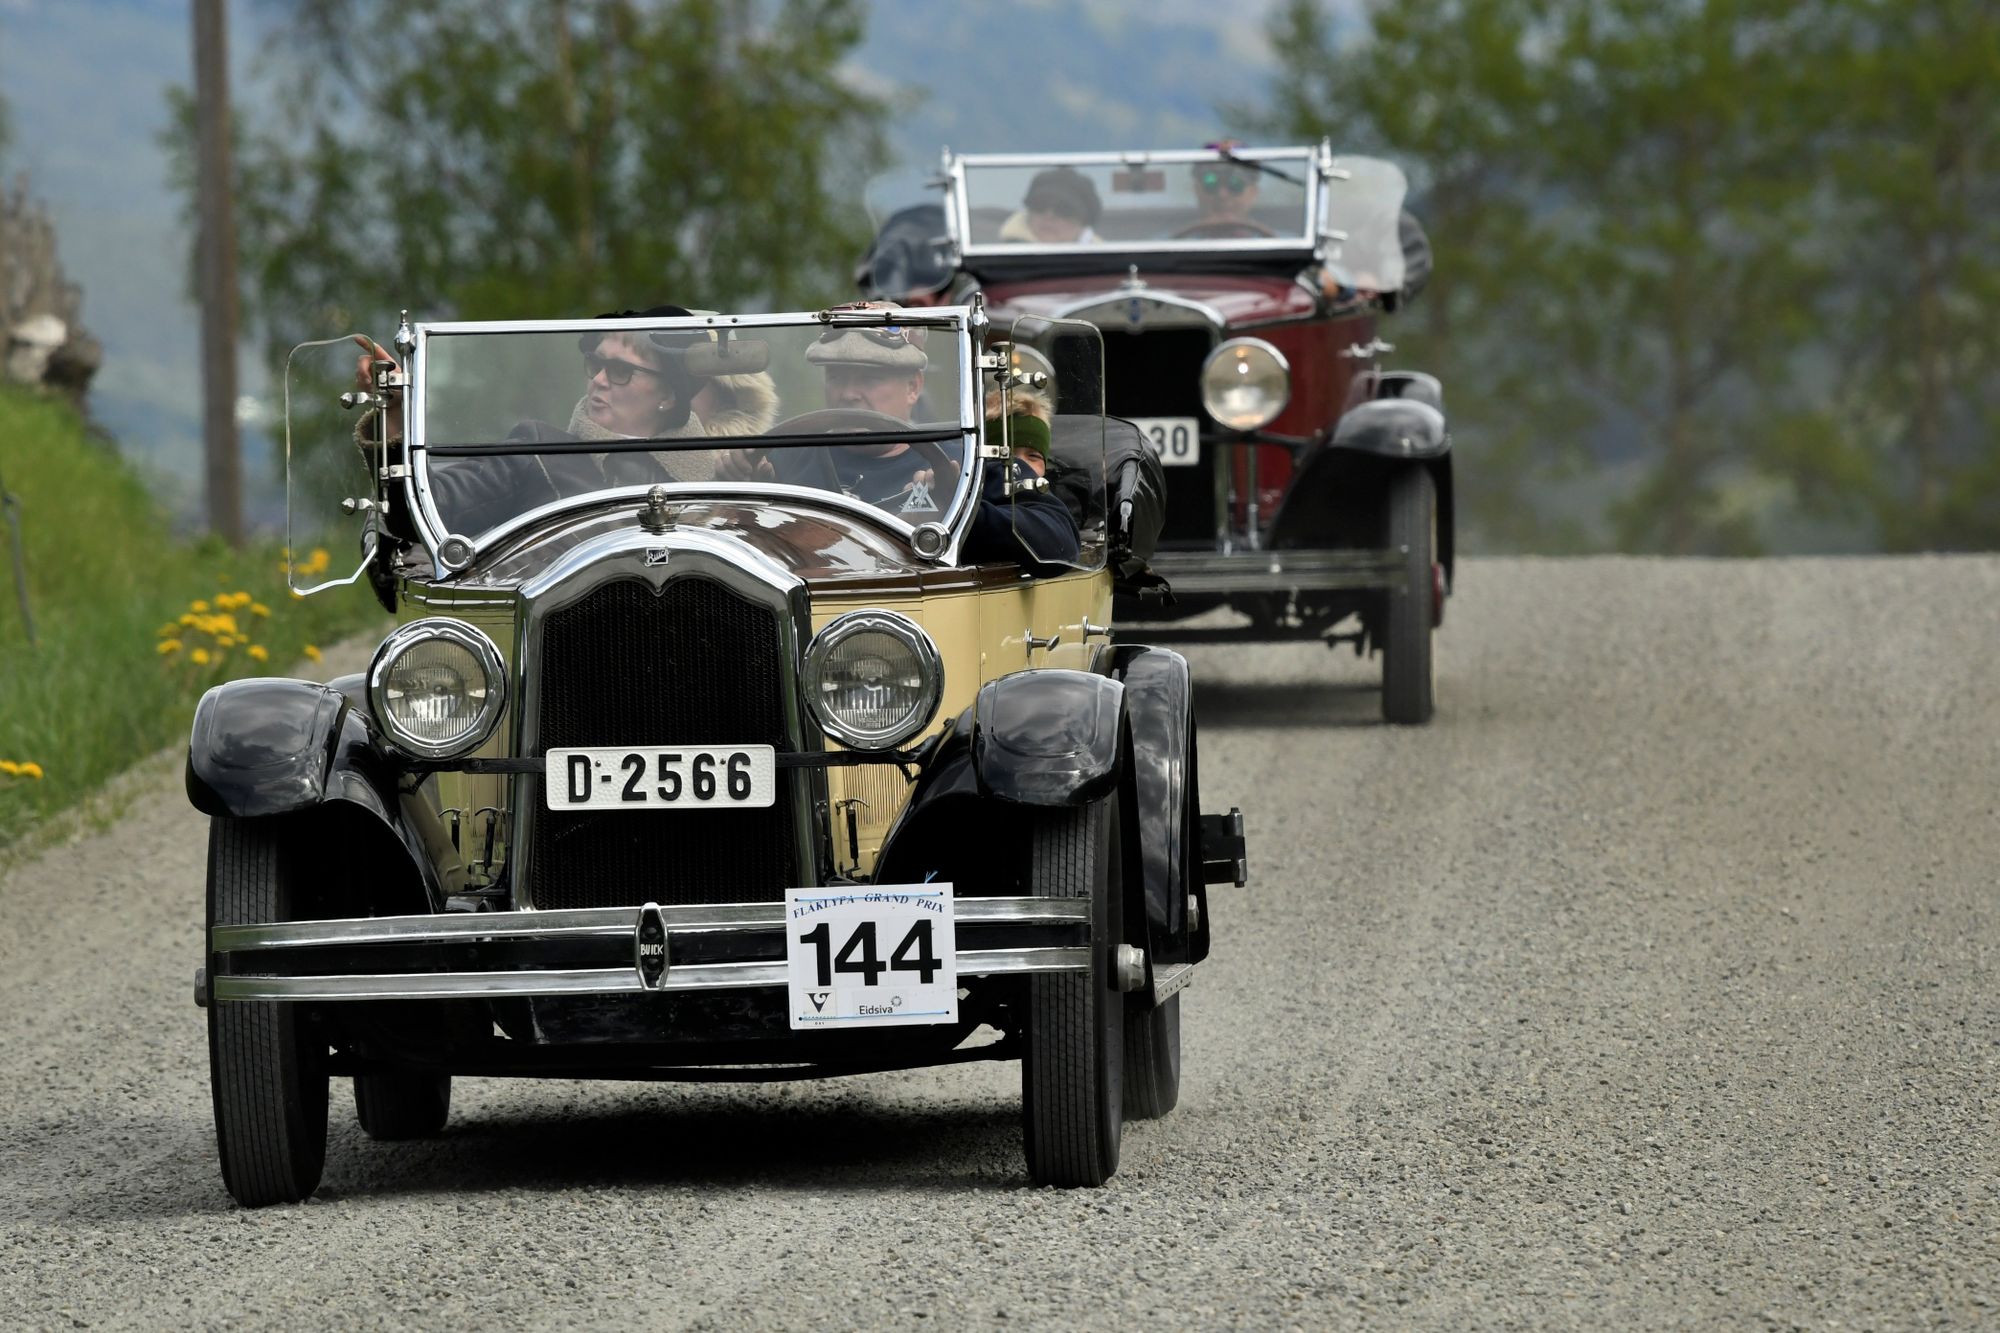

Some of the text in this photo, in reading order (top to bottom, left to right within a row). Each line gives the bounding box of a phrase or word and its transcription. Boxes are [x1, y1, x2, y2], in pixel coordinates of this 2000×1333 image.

[1150, 426, 1189, 456] 30
[567, 752, 752, 803] D-2566
[864, 893, 909, 904] GRAND
[916, 898, 945, 913] PRIX
[640, 944, 664, 955] BUICK
[800, 919, 942, 986] 144
[859, 1005, 893, 1015] Eidsiva
